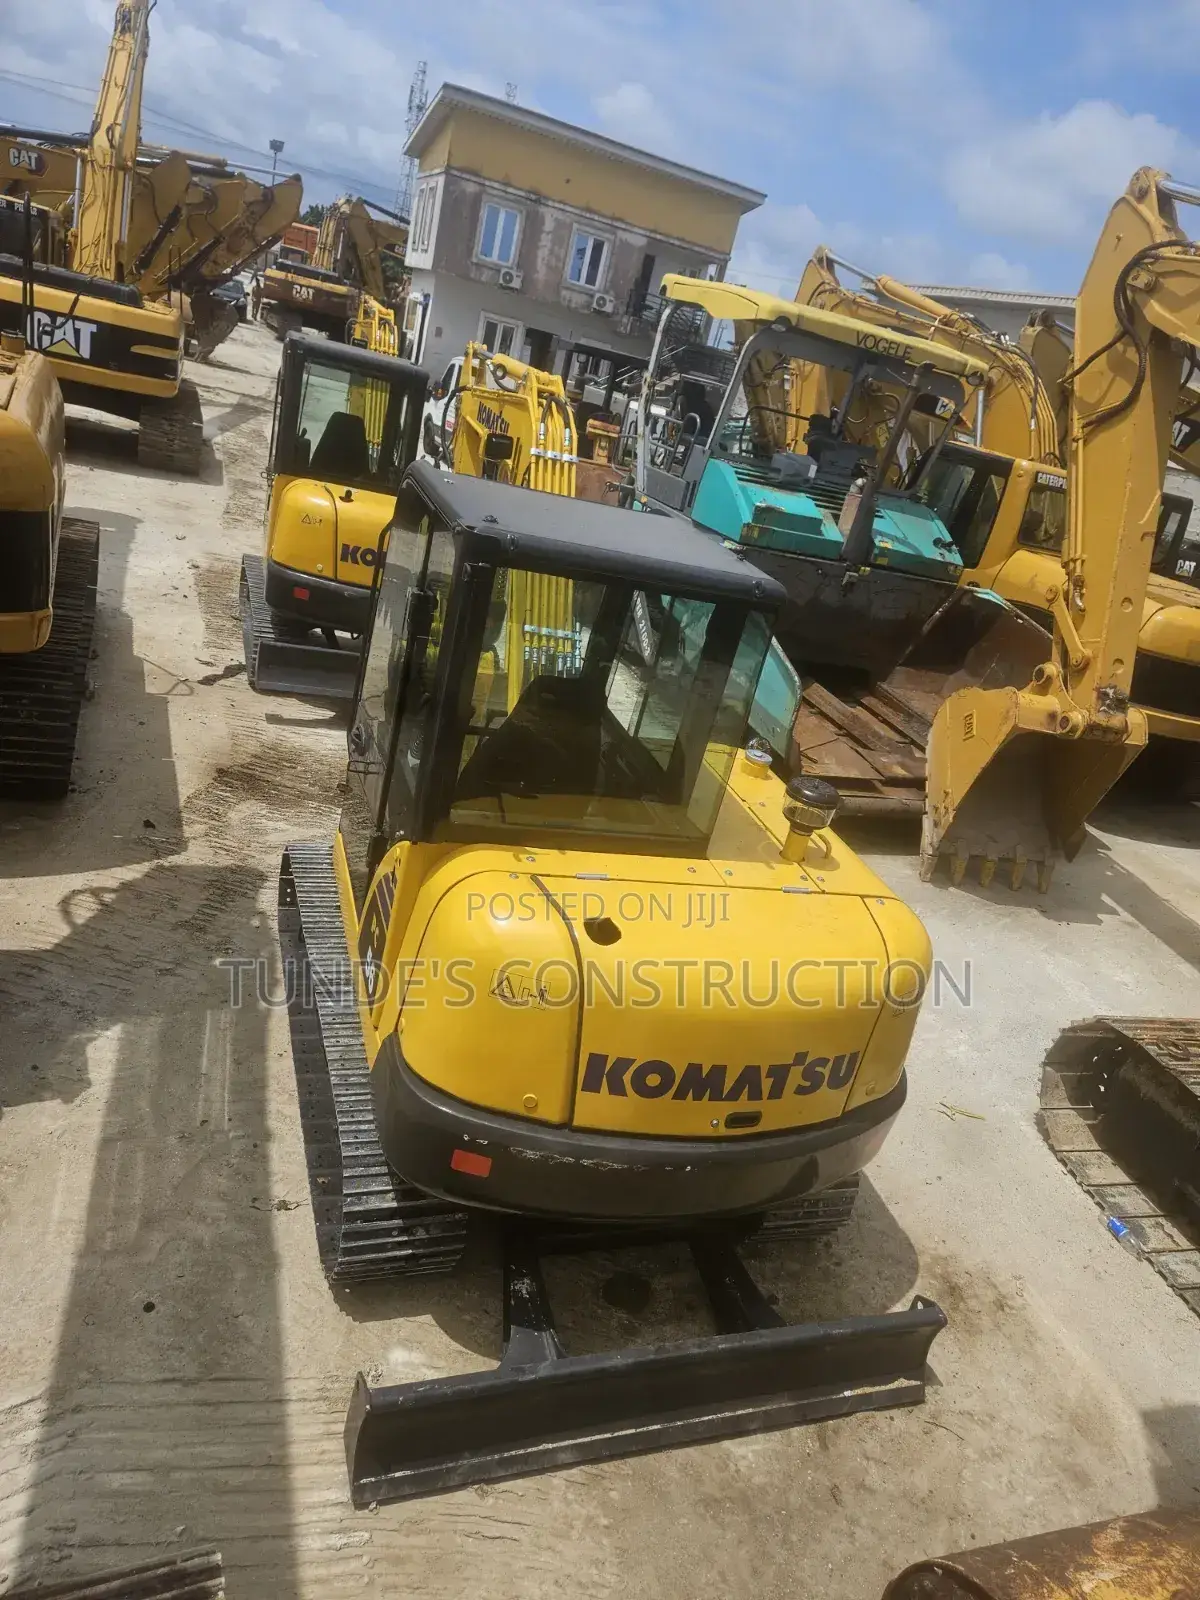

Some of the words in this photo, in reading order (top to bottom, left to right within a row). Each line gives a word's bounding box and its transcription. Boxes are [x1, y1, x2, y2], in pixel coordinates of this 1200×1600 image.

[9, 147, 38, 170] CAT
[292, 284, 315, 301] CAT
[26, 310, 98, 359] CAT
[476, 400, 511, 435] KOMATSU
[935, 398, 956, 416] CA
[1172, 421, 1191, 447] AT
[340, 542, 387, 569] KO
[1175, 559, 1197, 577] CAT
[580, 1050, 860, 1103] KOMATSU
